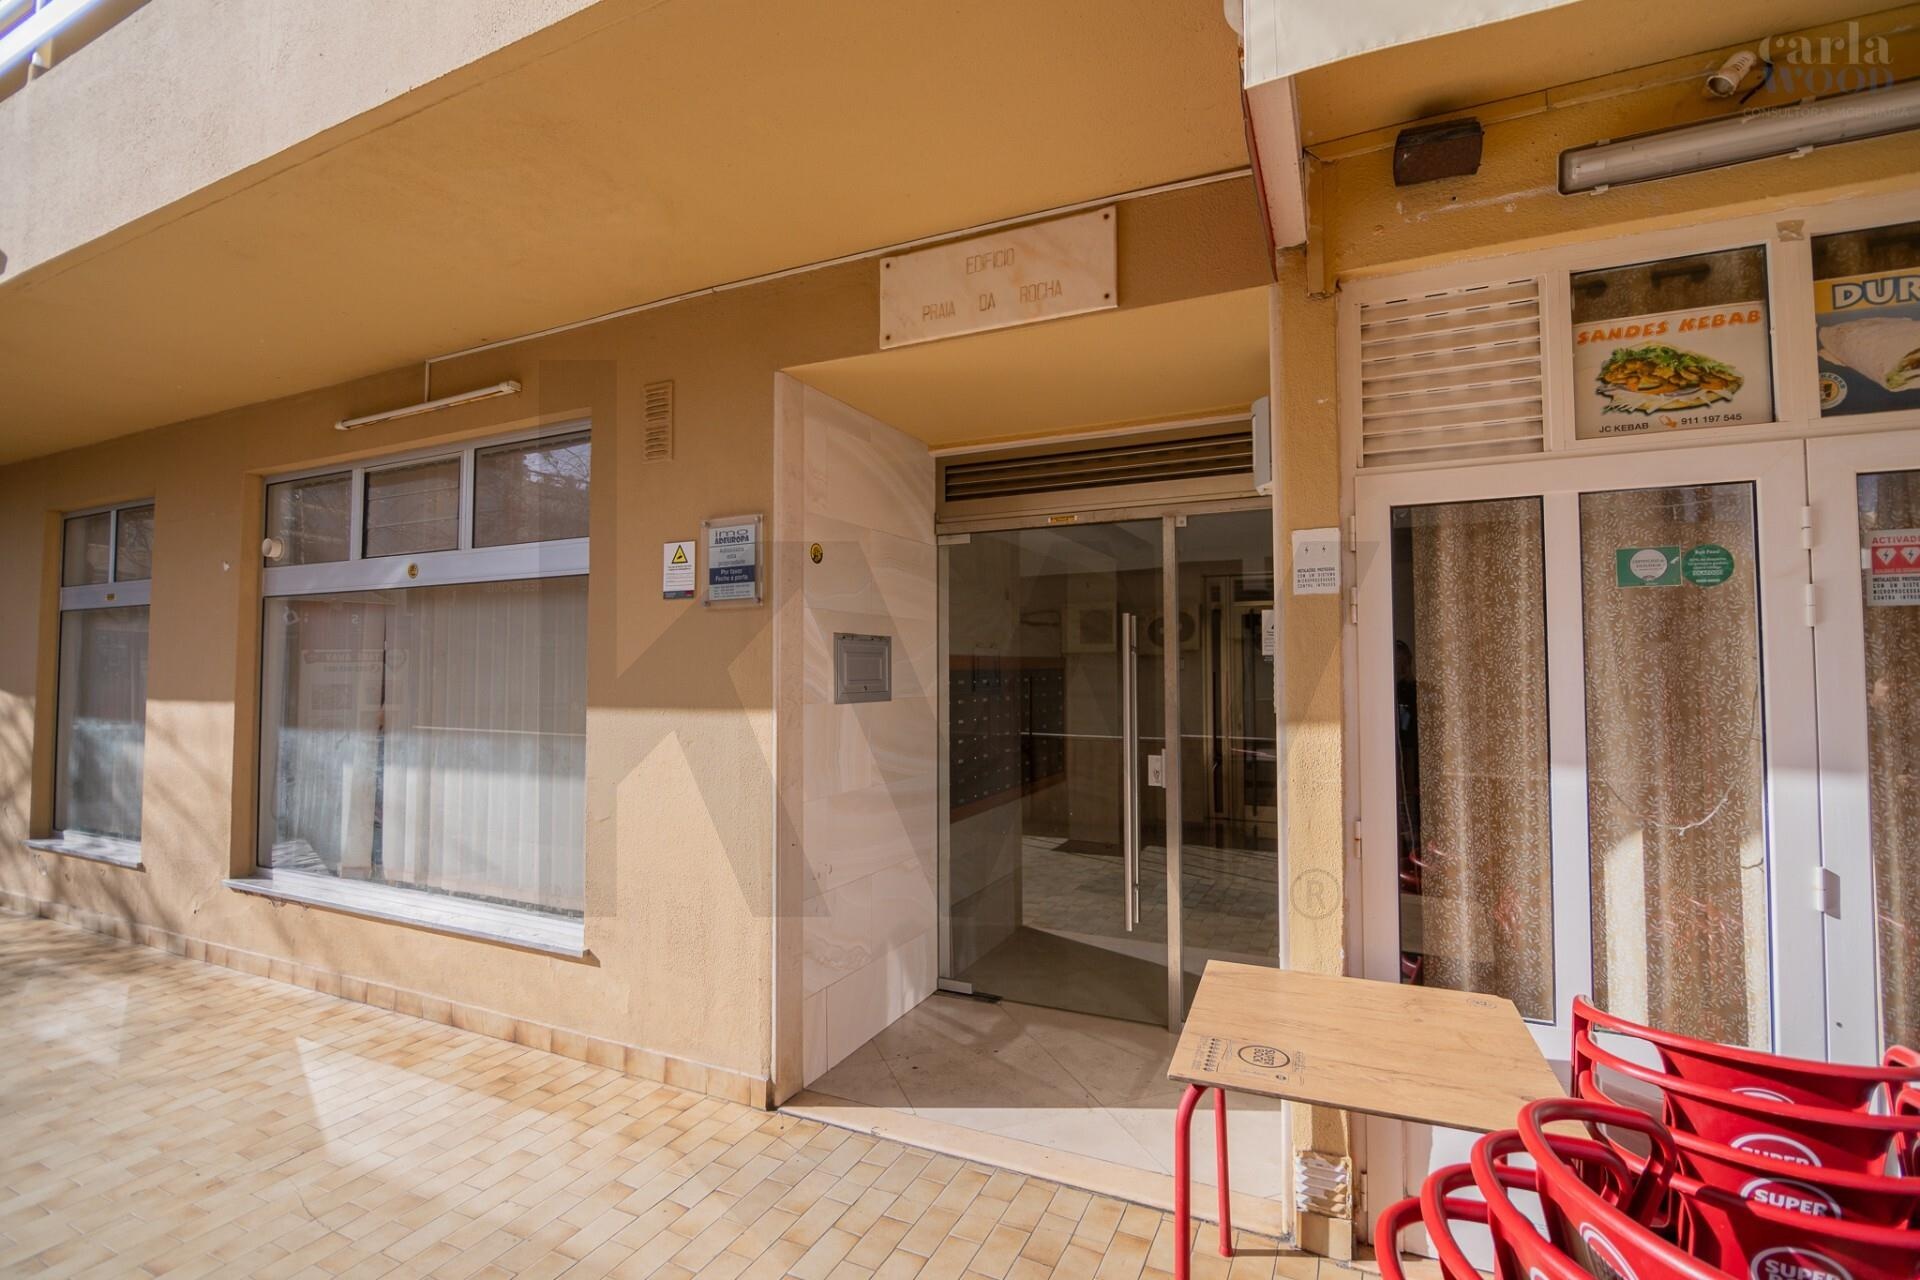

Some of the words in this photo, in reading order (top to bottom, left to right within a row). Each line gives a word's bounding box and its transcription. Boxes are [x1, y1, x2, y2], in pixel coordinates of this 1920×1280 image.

[922, 301, 956, 322] PRAIA
[978, 293, 996, 312] DA
[1019, 279, 1063, 304] ROCHA
[1576, 319, 1670, 346] SANDES
[1678, 309, 1762, 333] KEBAB
[1599, 424, 1612, 433] JC
[1614, 421, 1649, 433] KEBAB
[1681, 416, 1699, 425] 911
[1702, 414, 1721, 424] 197
[1723, 412, 1742, 422] 545
[1872, 535, 1920, 545] ACTIVAD
[1754, 1188, 1829, 1217] SUPER
